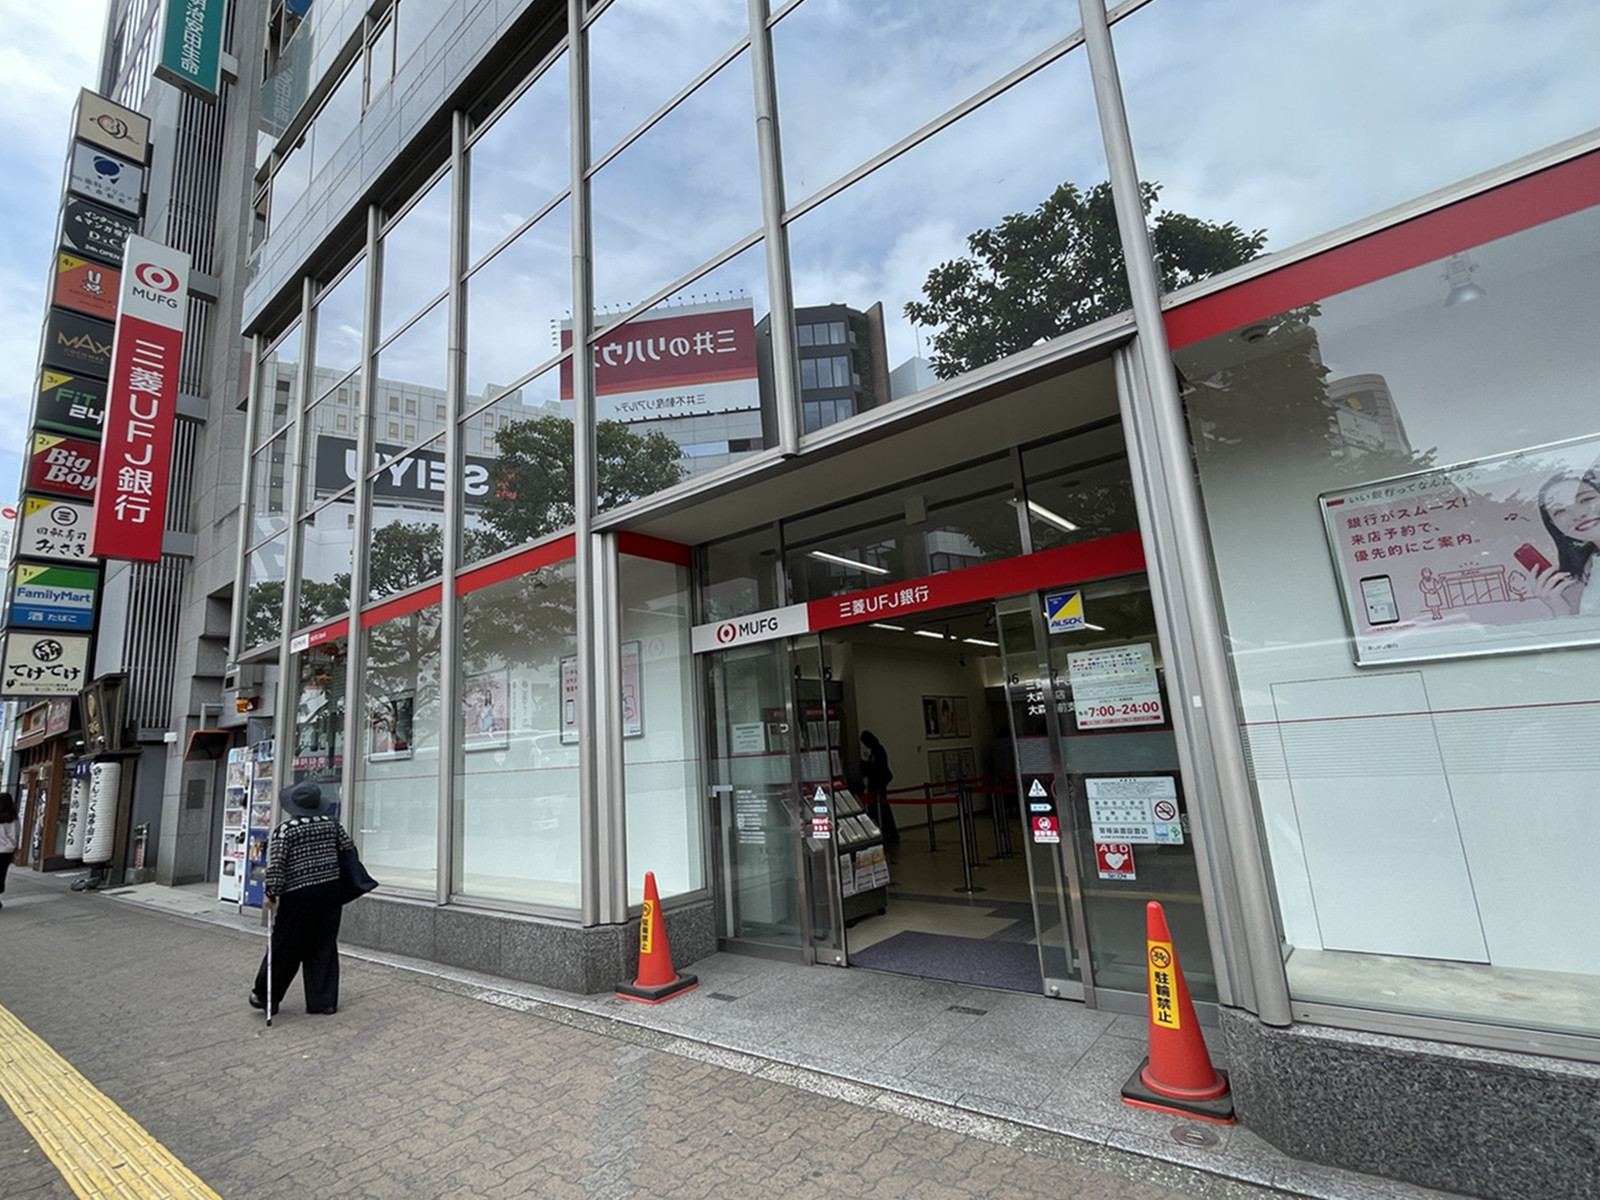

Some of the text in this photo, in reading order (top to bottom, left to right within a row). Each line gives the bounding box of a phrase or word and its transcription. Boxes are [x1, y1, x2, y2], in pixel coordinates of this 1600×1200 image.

[132, 287, 178, 309] MUFG
[56, 331, 112, 358] MAX
[69, 403, 105, 425] 24
[114, 338, 166, 523] 三菱UFJ銀行
[44, 447, 92, 473] Big
[44, 464, 98, 491] Boy
[1351, 522, 1440, 546] 来店予約で、
[35, 538, 86, 557] みさき
[1354, 533, 1480, 563] 優先的にご案内。
[16, 587, 92, 603] FamilyMart
[47, 613, 78, 623] たばこ
[739, 585, 929, 637] MUFG 三菱UFJ銀行
[1051, 616, 1083, 628] ALSOK
[9, 663, 81, 681] てけてけ
[1098, 843, 1129, 853] AED
[1154, 971, 1173, 1024] 駐輪禁止
